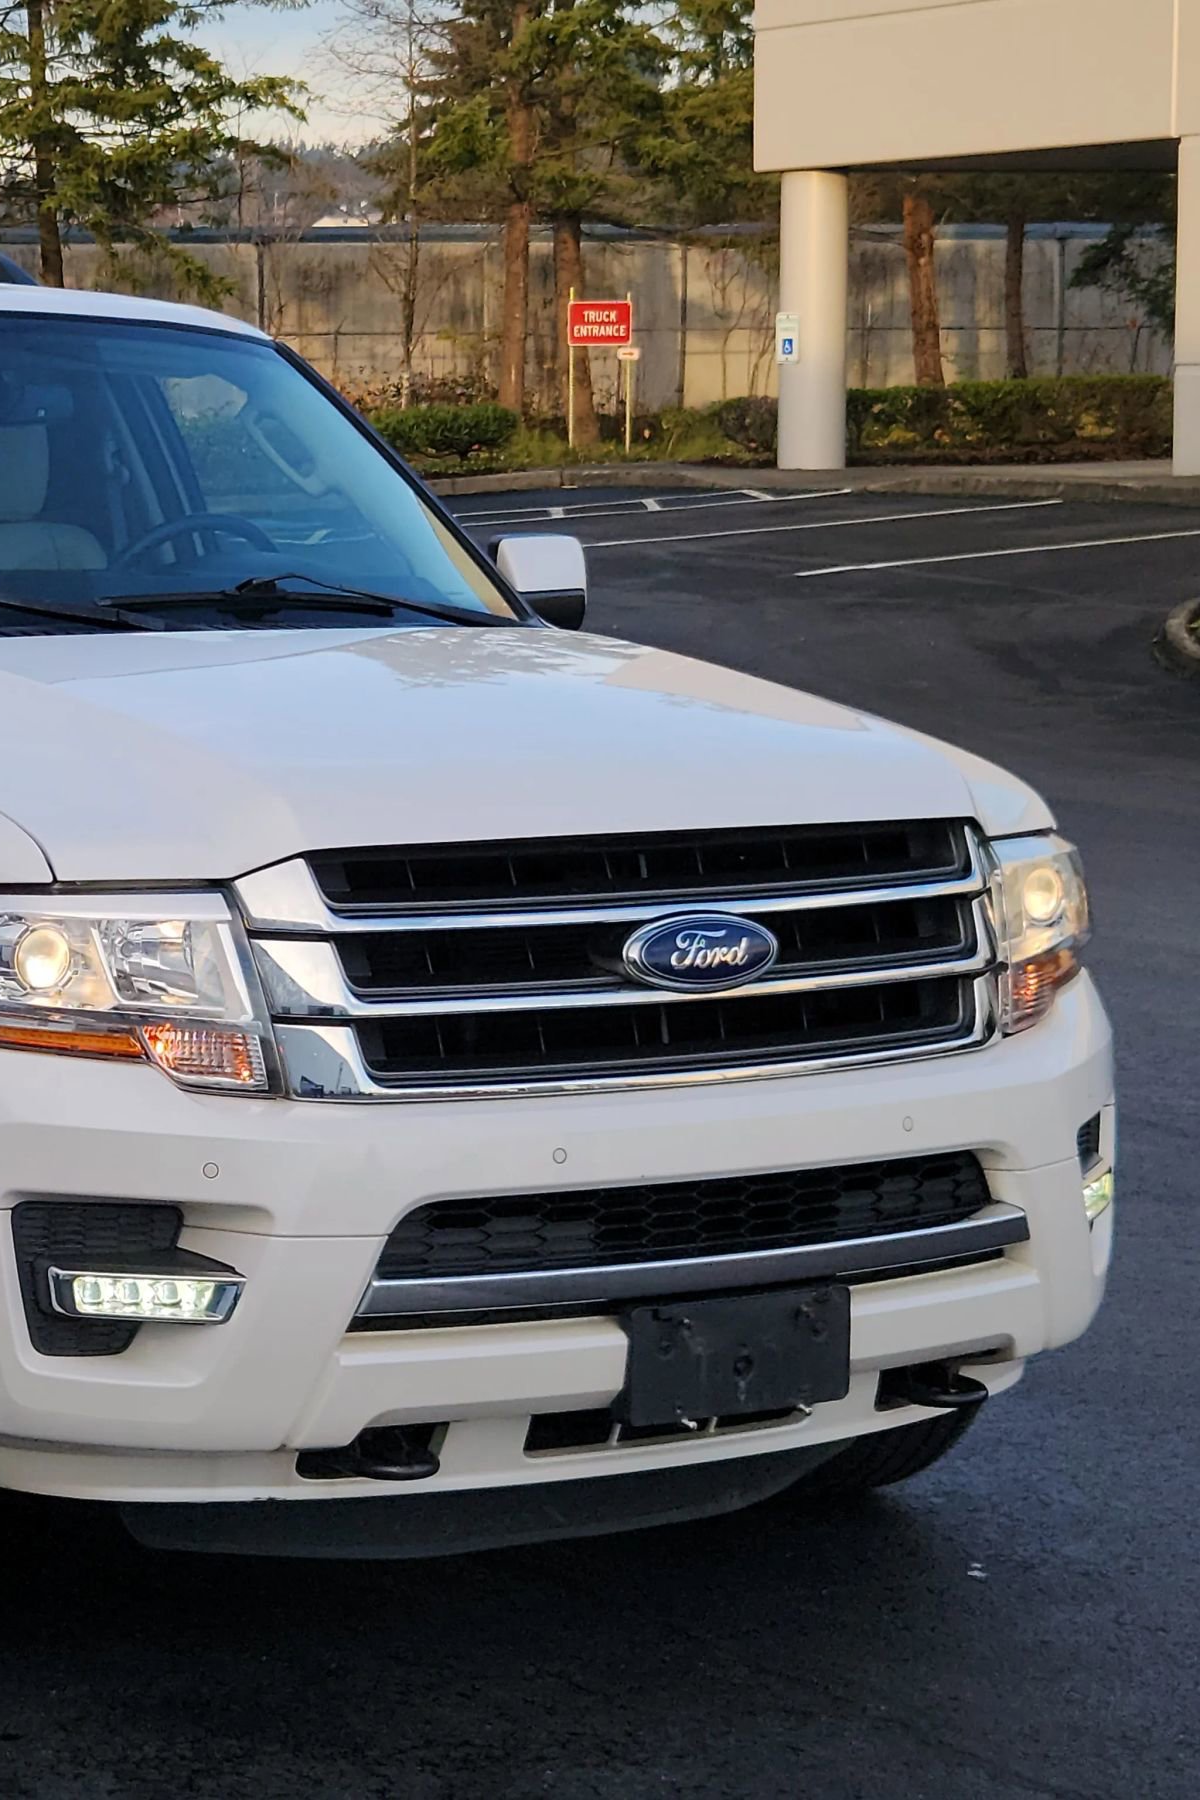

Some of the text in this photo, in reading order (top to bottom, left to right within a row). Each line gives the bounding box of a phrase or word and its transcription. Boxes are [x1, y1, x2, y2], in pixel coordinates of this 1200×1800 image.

[582, 310, 617, 323] TRUCK
[573, 324, 626, 338] ENTRANCE
[670, 929, 749, 970] Ford
